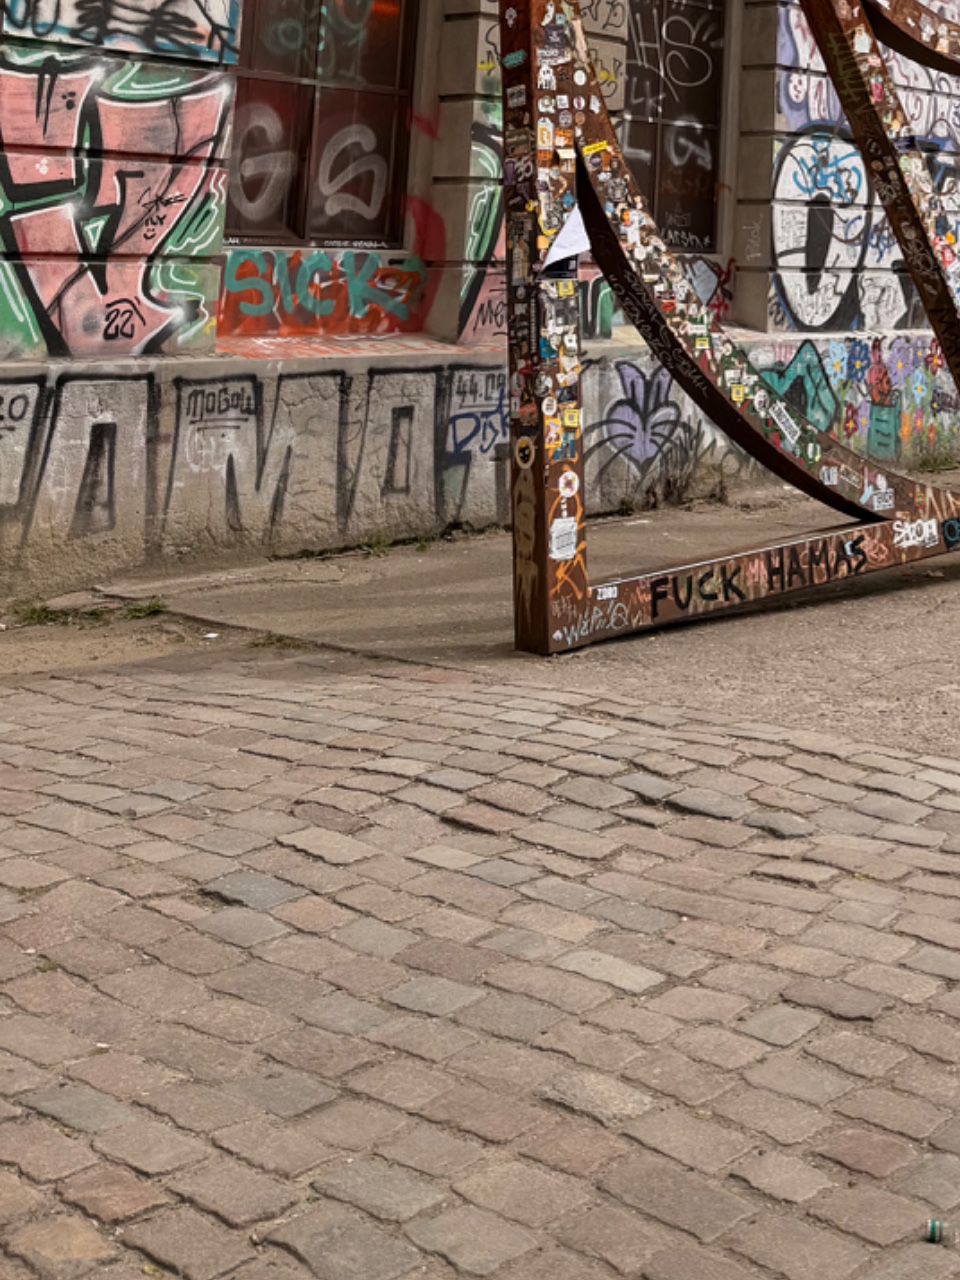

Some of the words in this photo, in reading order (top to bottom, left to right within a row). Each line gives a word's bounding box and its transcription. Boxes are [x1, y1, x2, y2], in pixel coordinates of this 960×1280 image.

[225, 249, 410, 321] SICK
[650, 565, 746, 617] FUCK
[767, 535, 867, 592] HAMAS
